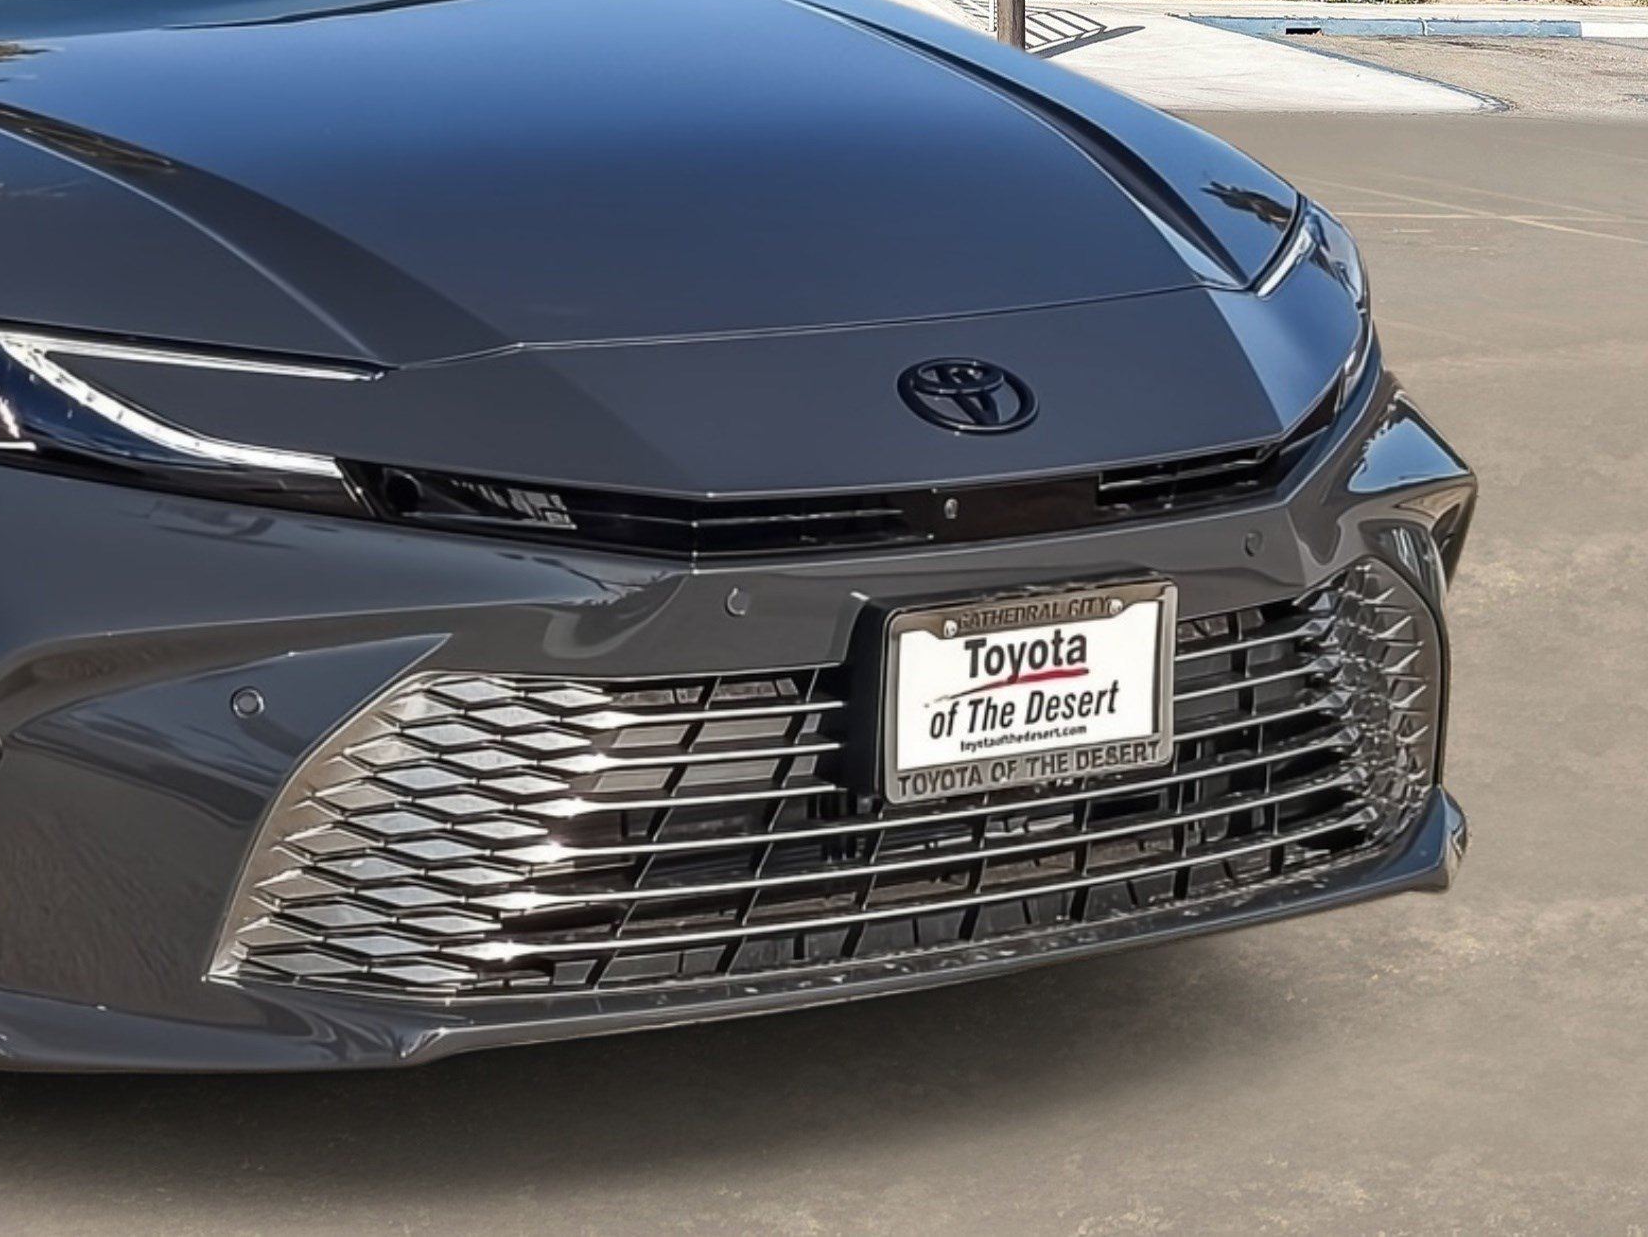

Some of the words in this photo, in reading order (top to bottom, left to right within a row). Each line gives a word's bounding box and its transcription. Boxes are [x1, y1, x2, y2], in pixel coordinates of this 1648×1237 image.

[964, 629, 1088, 683] Toyota
[929, 700, 959, 740] of
[967, 696, 1016, 734] The
[1024, 686, 1120, 725] Desert
[898, 765, 983, 798] TOYOTA
[990, 760, 1018, 784] OF
[1025, 751, 1069, 778] THE
[1075, 740, 1162, 771] DESERT
